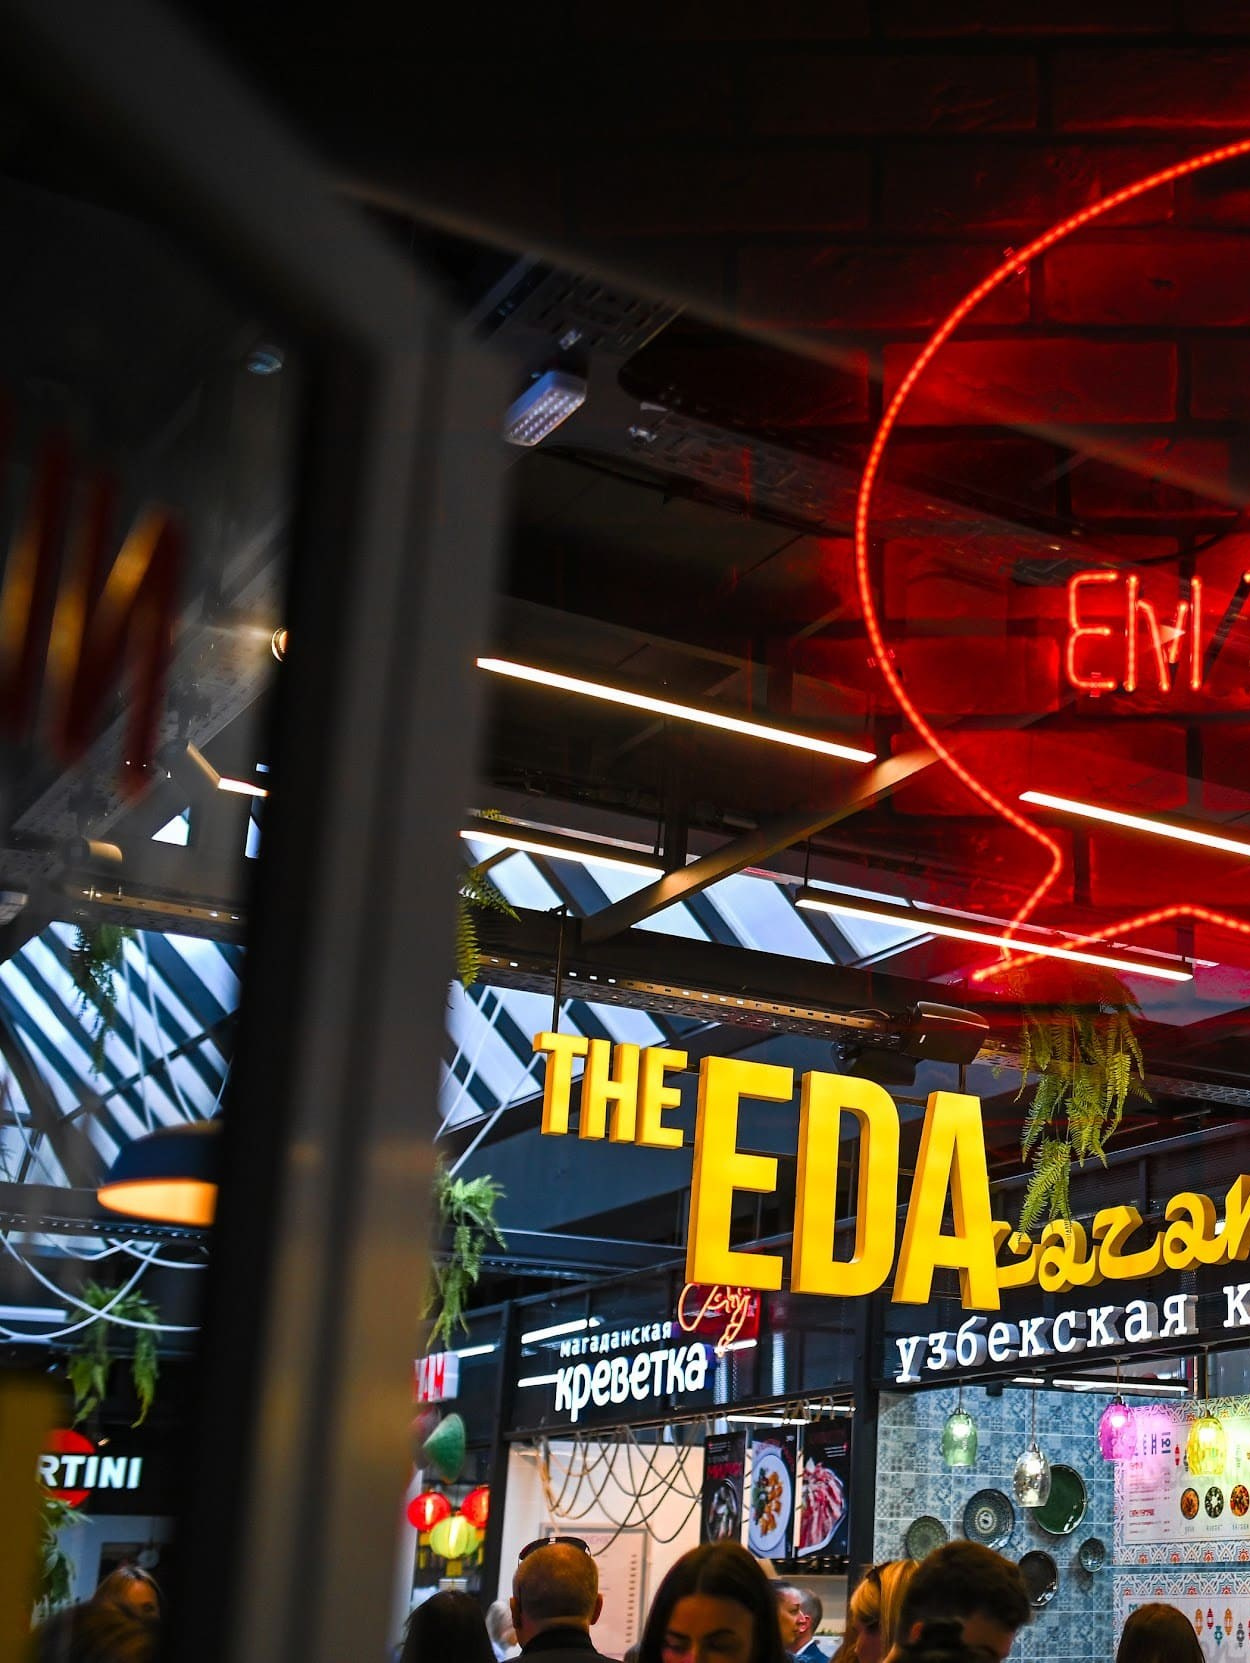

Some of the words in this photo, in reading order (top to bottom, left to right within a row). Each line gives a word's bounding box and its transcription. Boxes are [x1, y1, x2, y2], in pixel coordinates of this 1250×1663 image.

[1067, 570, 1201, 692] ЕМ
[533, 1031, 689, 1150] THE
[685, 1055, 1001, 1311] EDA
[554, 1342, 709, 1423] креветка
[559, 1321, 677, 1358] магаданская
[895, 1292, 1200, 1384] узбекская
[37, 1453, 144, 1490] RTINI
